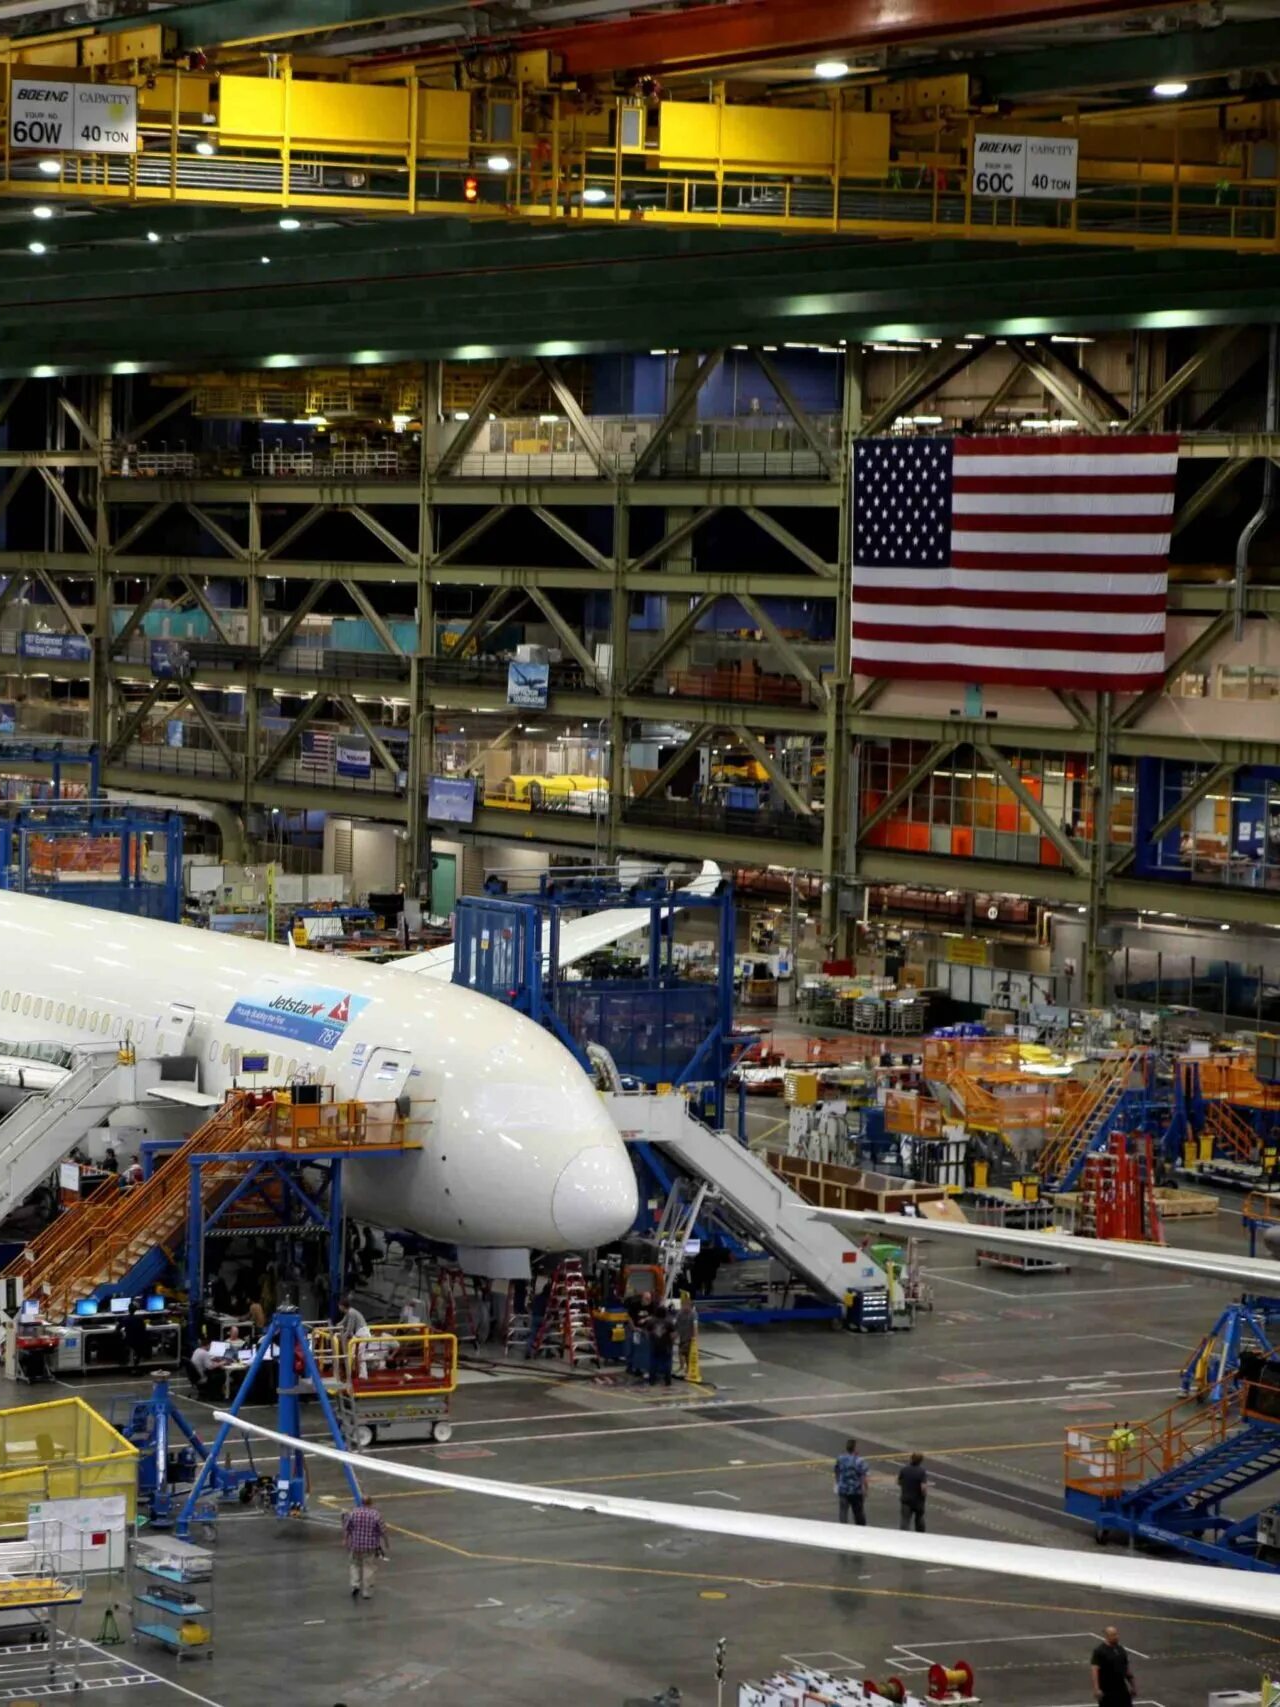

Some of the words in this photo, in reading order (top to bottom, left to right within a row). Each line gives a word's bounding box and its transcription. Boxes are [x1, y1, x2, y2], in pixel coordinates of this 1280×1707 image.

[17, 88, 69, 103] BOEING
[80, 92, 131, 105] CAPACITY
[13, 121, 62, 144] 60W
[81, 125, 102, 142] 40
[105, 131, 129, 144] TON
[979, 141, 1023, 154] BOEING
[1031, 144, 1074, 156] CAPACITY
[976, 172, 1014, 193] 60C
[1031, 174, 1049, 190] 40
[1051, 179, 1071, 191] TON
[269, 995, 310, 1015] Jetstar
[318, 1027, 341, 1045] 787
